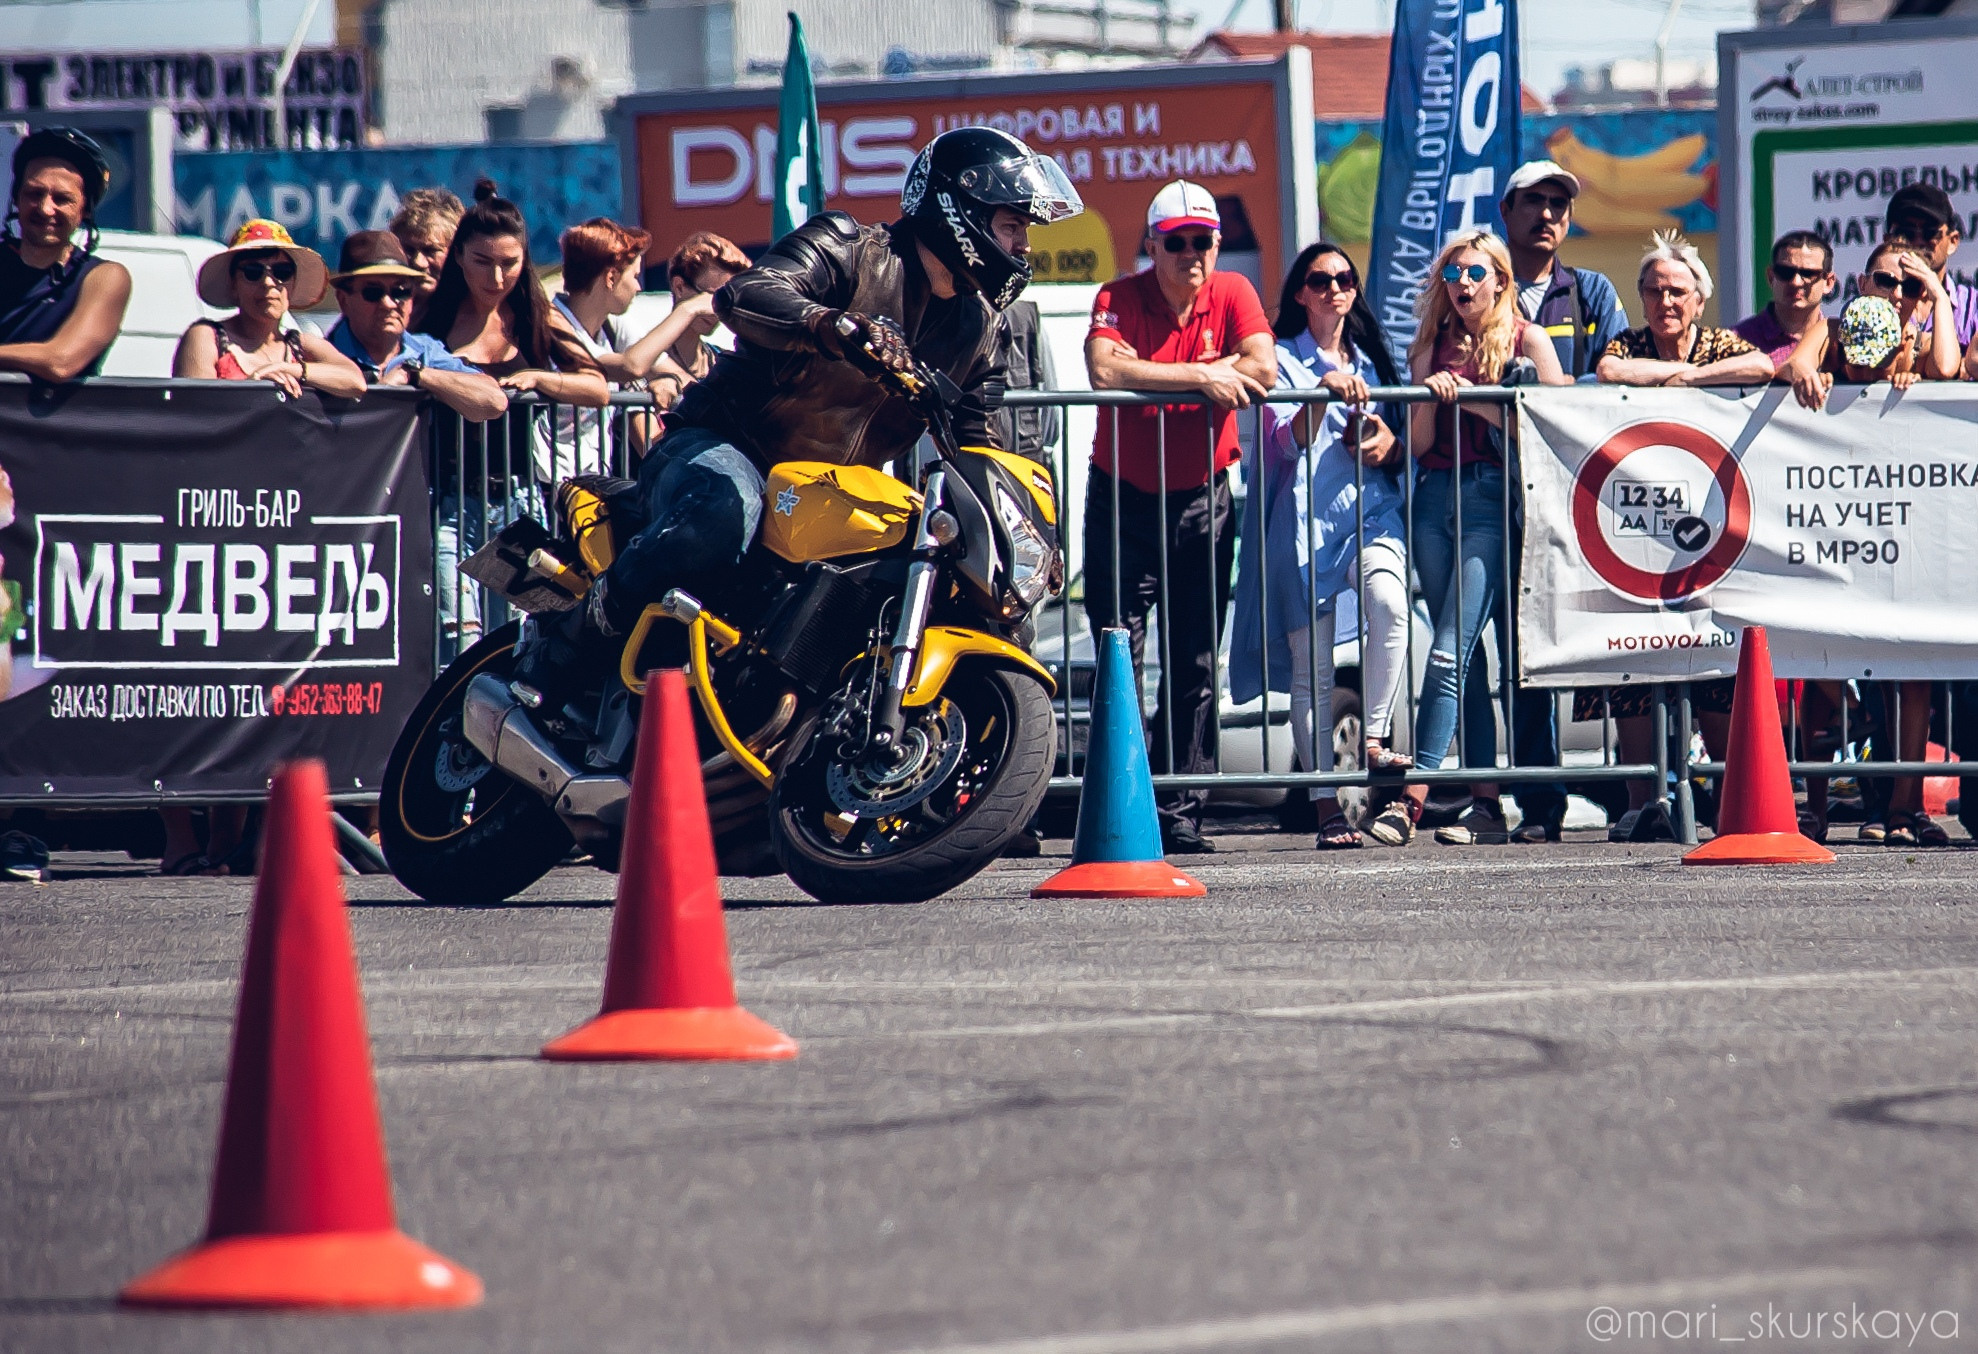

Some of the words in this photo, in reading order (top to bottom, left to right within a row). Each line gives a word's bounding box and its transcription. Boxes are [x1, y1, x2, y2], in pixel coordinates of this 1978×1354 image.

[1132, 102, 1161, 137] И
[1099, 140, 1256, 181] ТЕХНИКА
[936, 192, 986, 267] SHARK
[1786, 463, 1978, 490] ПОСТАНОВКА
[177, 489, 300, 528] ГРИЛЬ-БАР
[1786, 503, 1827, 527] НА
[1835, 502, 1912, 527] УЧЕТ
[1788, 541, 1805, 564] В
[1816, 540, 1900, 565] МРЭО
[51, 541, 390, 647] МЕДВЕДЬ
[1607, 631, 1736, 651] MOTOVOZ.RU
[50, 685, 107, 718] ЗАКАЗ
[110, 684, 200, 722] ДОСТАВКИ
[203, 684, 226, 718] ПО
